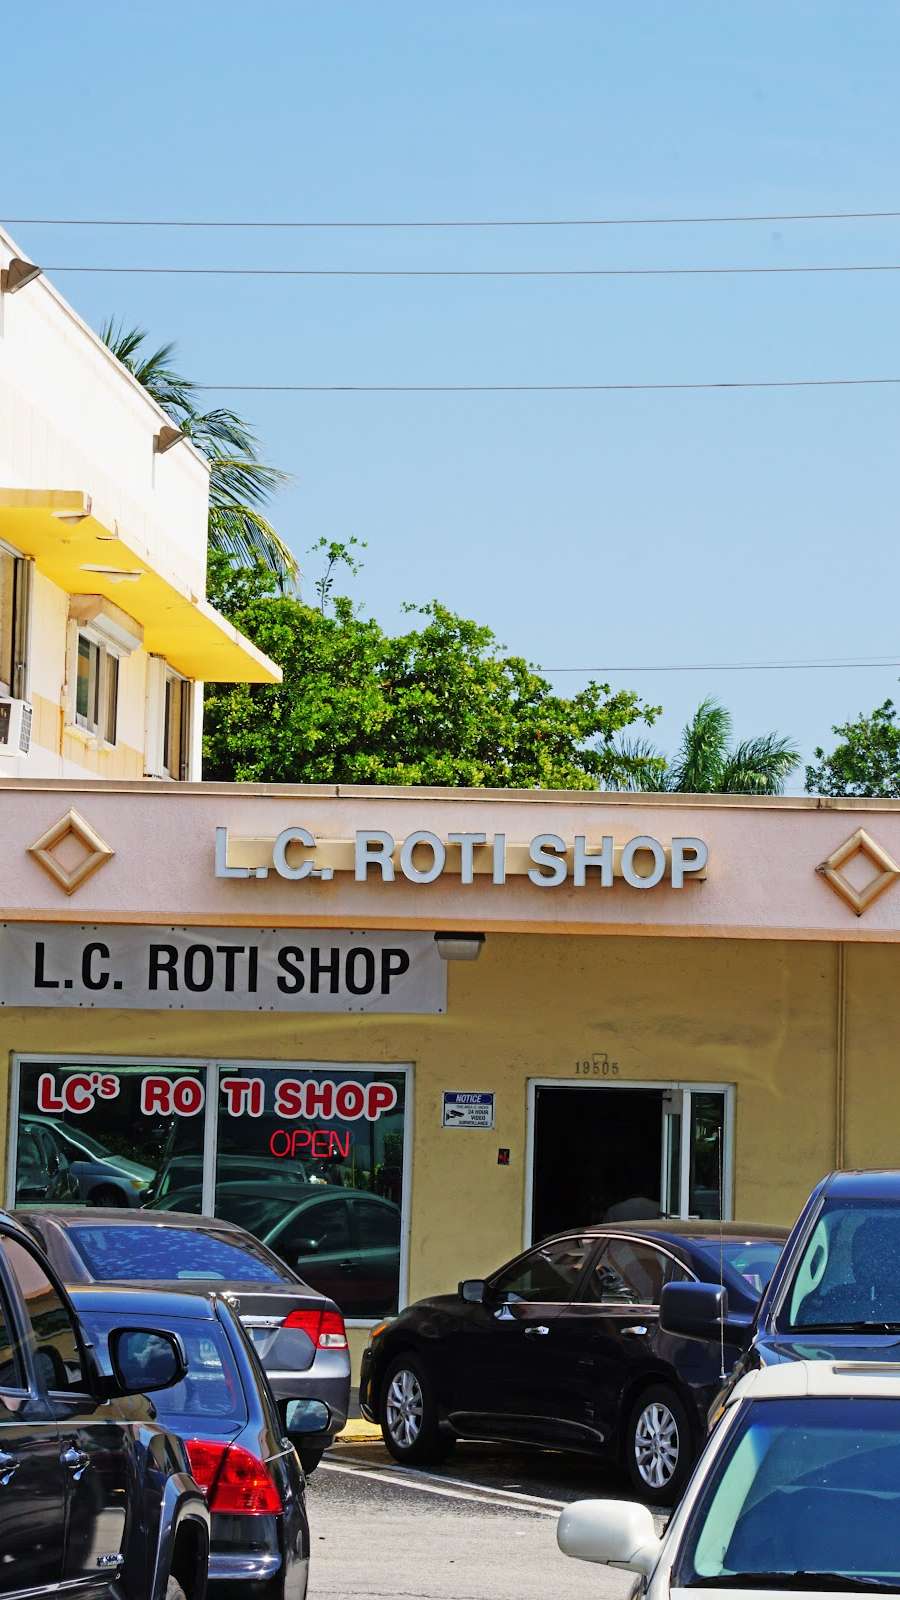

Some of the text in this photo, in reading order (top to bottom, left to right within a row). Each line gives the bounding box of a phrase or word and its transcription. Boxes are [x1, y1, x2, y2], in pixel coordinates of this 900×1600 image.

[215, 826, 709, 889] L.C. ROTI SHOP
[34, 942, 411, 995] L.C. ROTI SHOP
[38, 1072, 120, 1114] LC's
[274, 1079, 397, 1121] SHOP
[455, 1094, 482, 1103] NOTICE
[270, 1129, 350, 1158] OPEN
